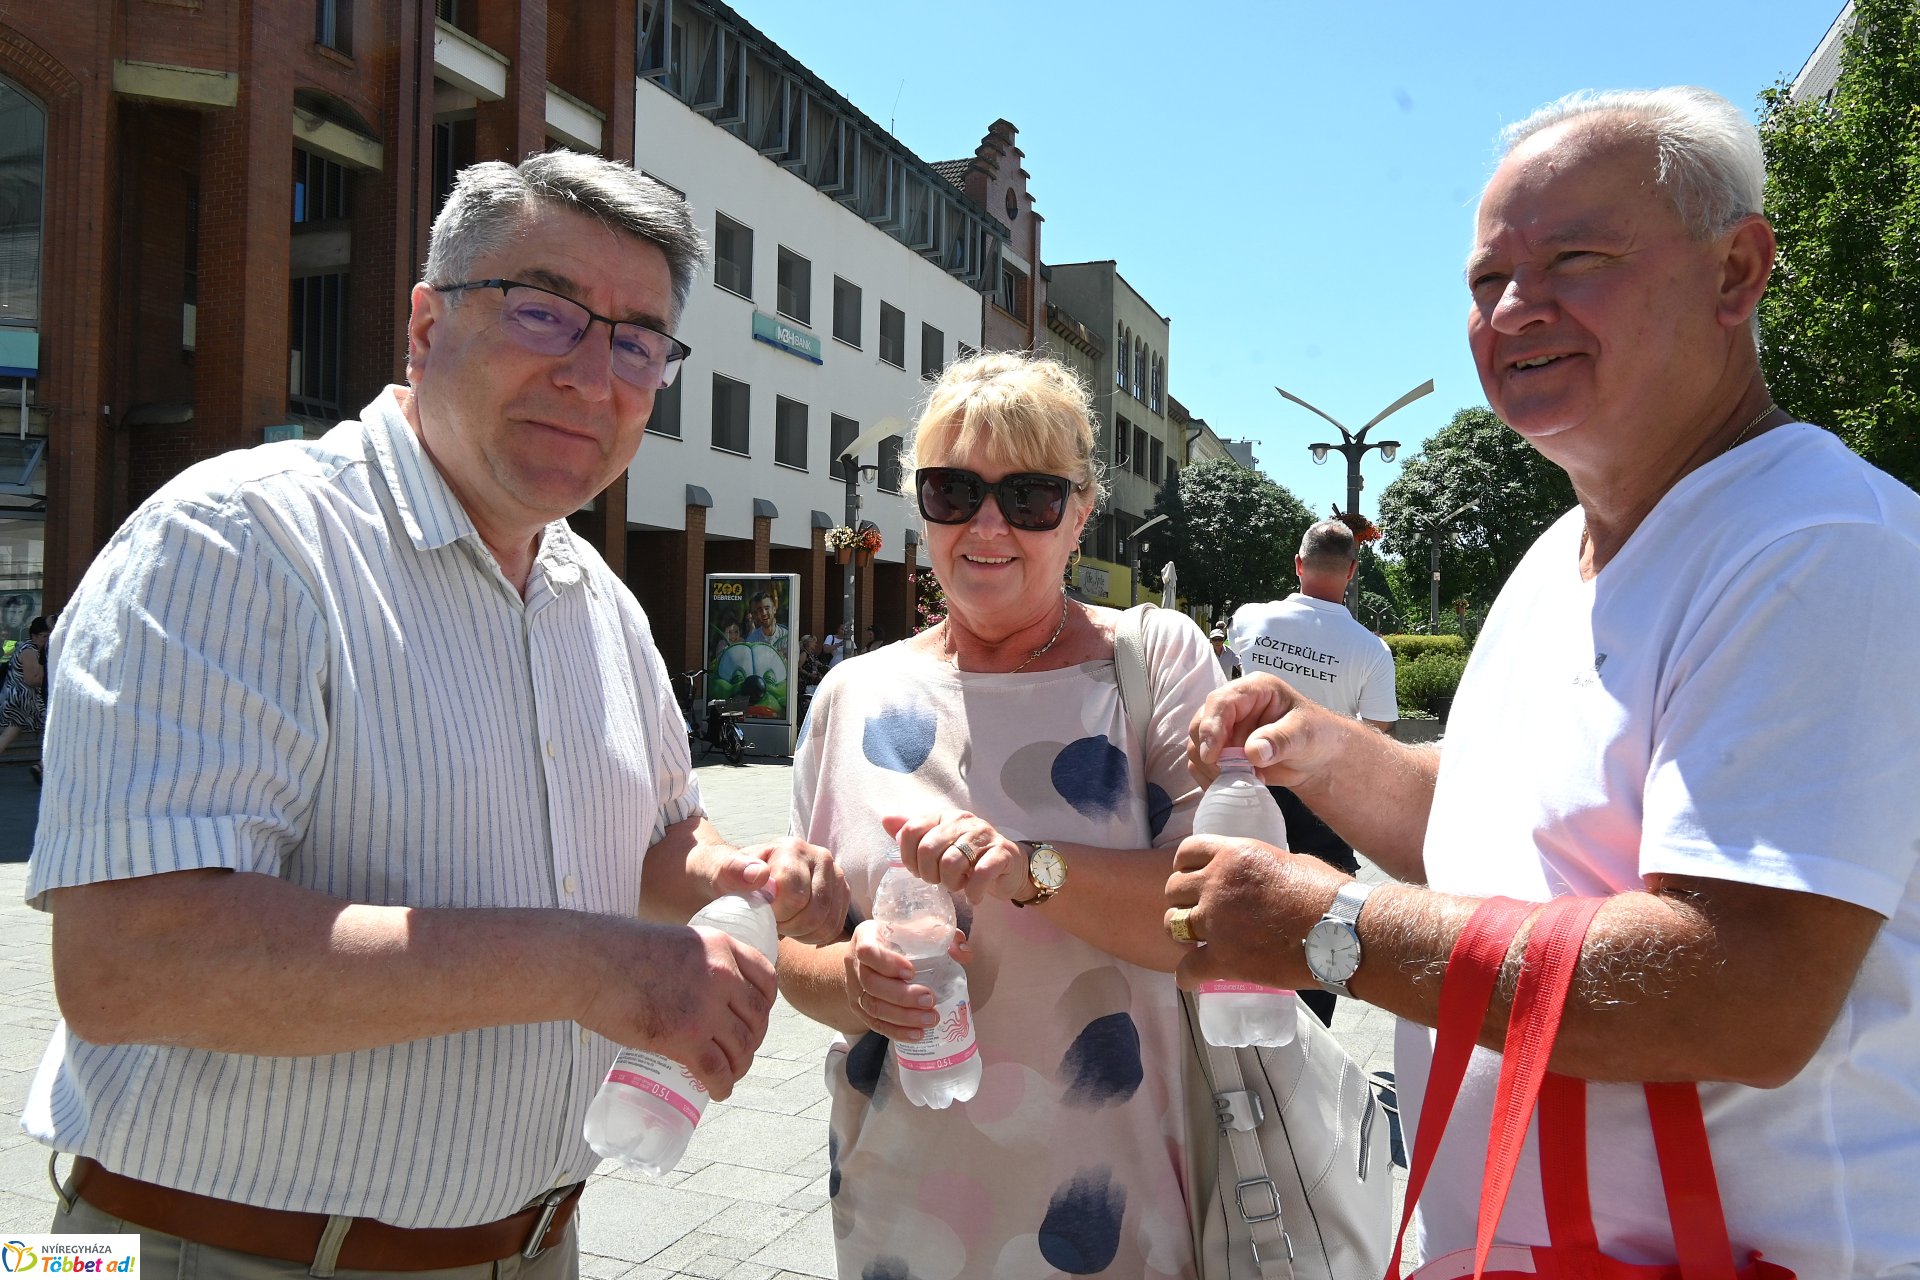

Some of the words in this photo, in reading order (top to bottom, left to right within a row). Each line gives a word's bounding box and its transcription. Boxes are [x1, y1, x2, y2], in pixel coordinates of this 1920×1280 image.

[778, 326, 794, 346] MBH
[795, 336, 811, 351] BANK
[714, 583, 742, 595] ZOO
[1254, 635, 1340, 666] KÖZTERÜLET-
[1251, 652, 1337, 683] FELÜGYELET
